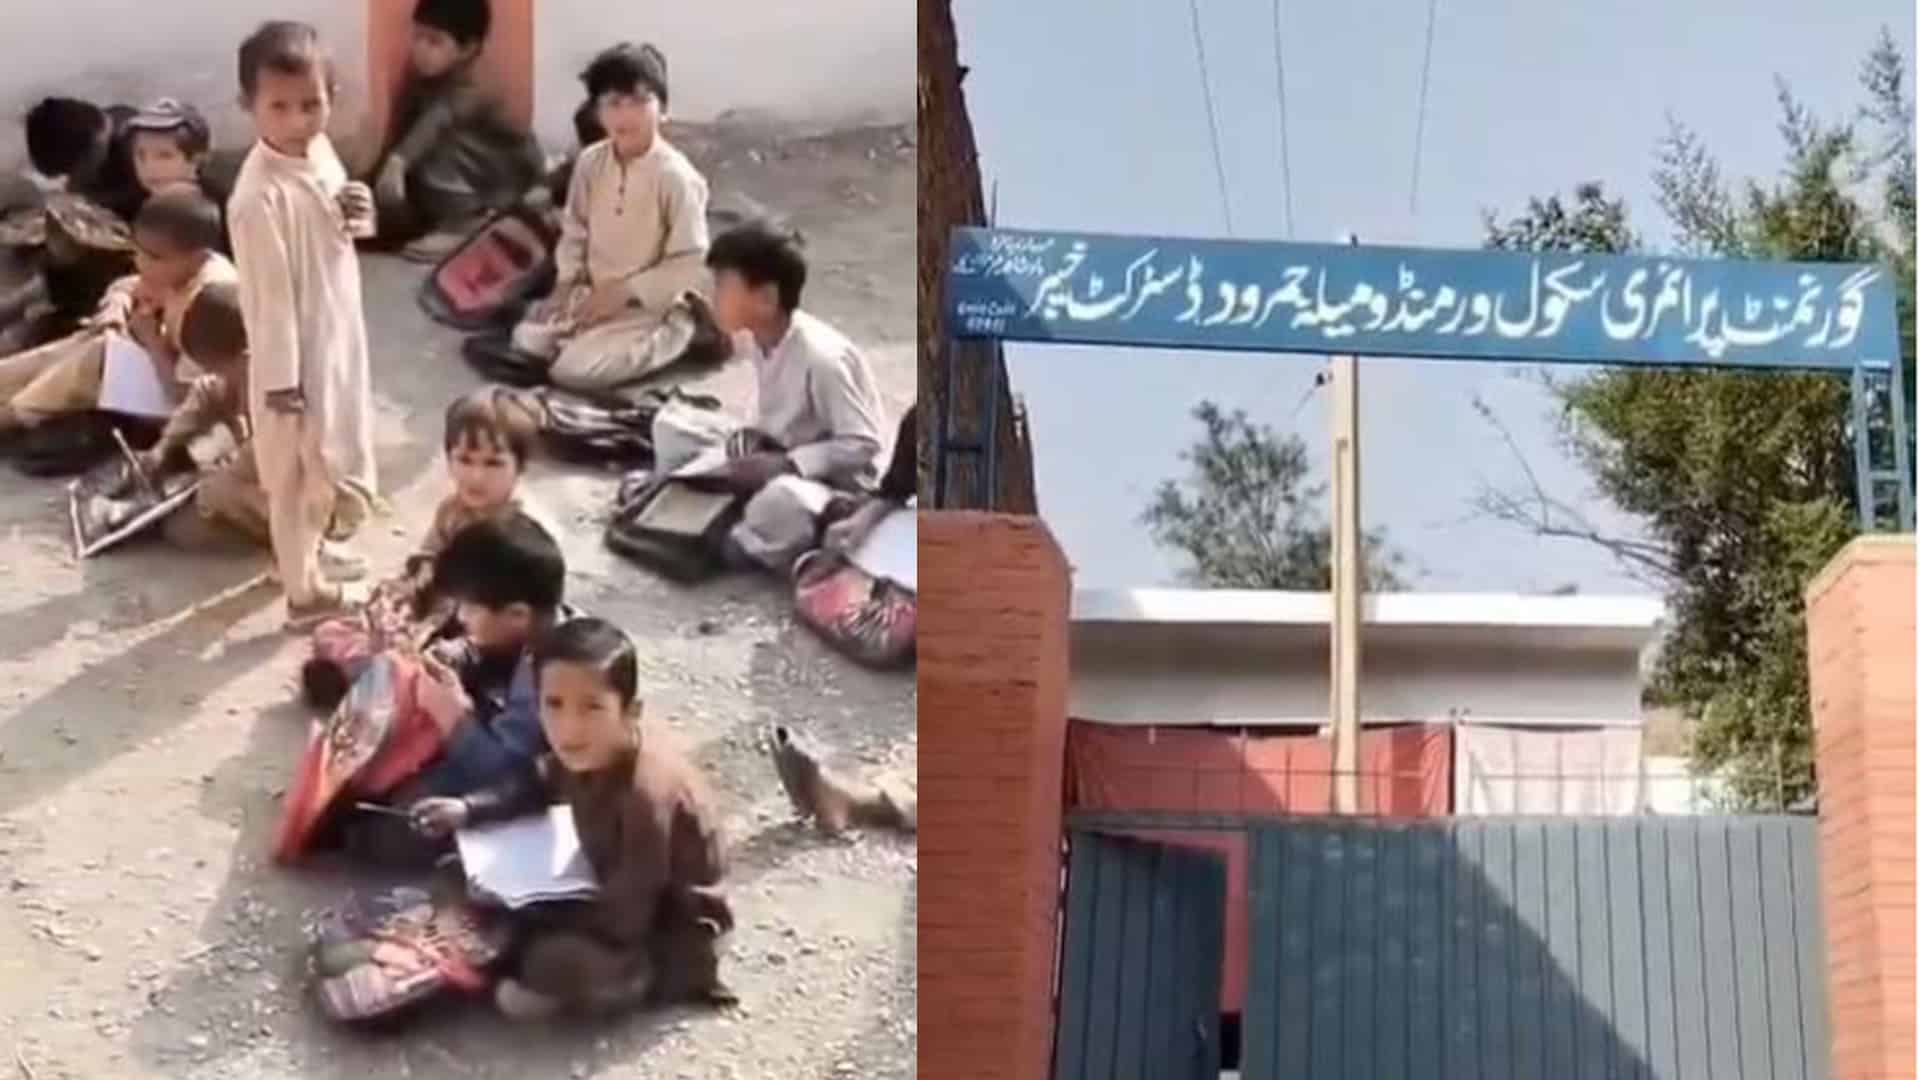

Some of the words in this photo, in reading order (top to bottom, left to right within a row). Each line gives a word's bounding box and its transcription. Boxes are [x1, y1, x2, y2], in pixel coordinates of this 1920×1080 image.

[1023, 242, 1088, 321] خیبر
[1067, 247, 1204, 326] ڈسٹرکٹ
[1202, 264, 1310, 329] جمرود
[1494, 256, 1607, 338] سکول
[1600, 262, 1725, 358] پرائمری
[1721, 265, 1880, 349] گورنمنٹ
